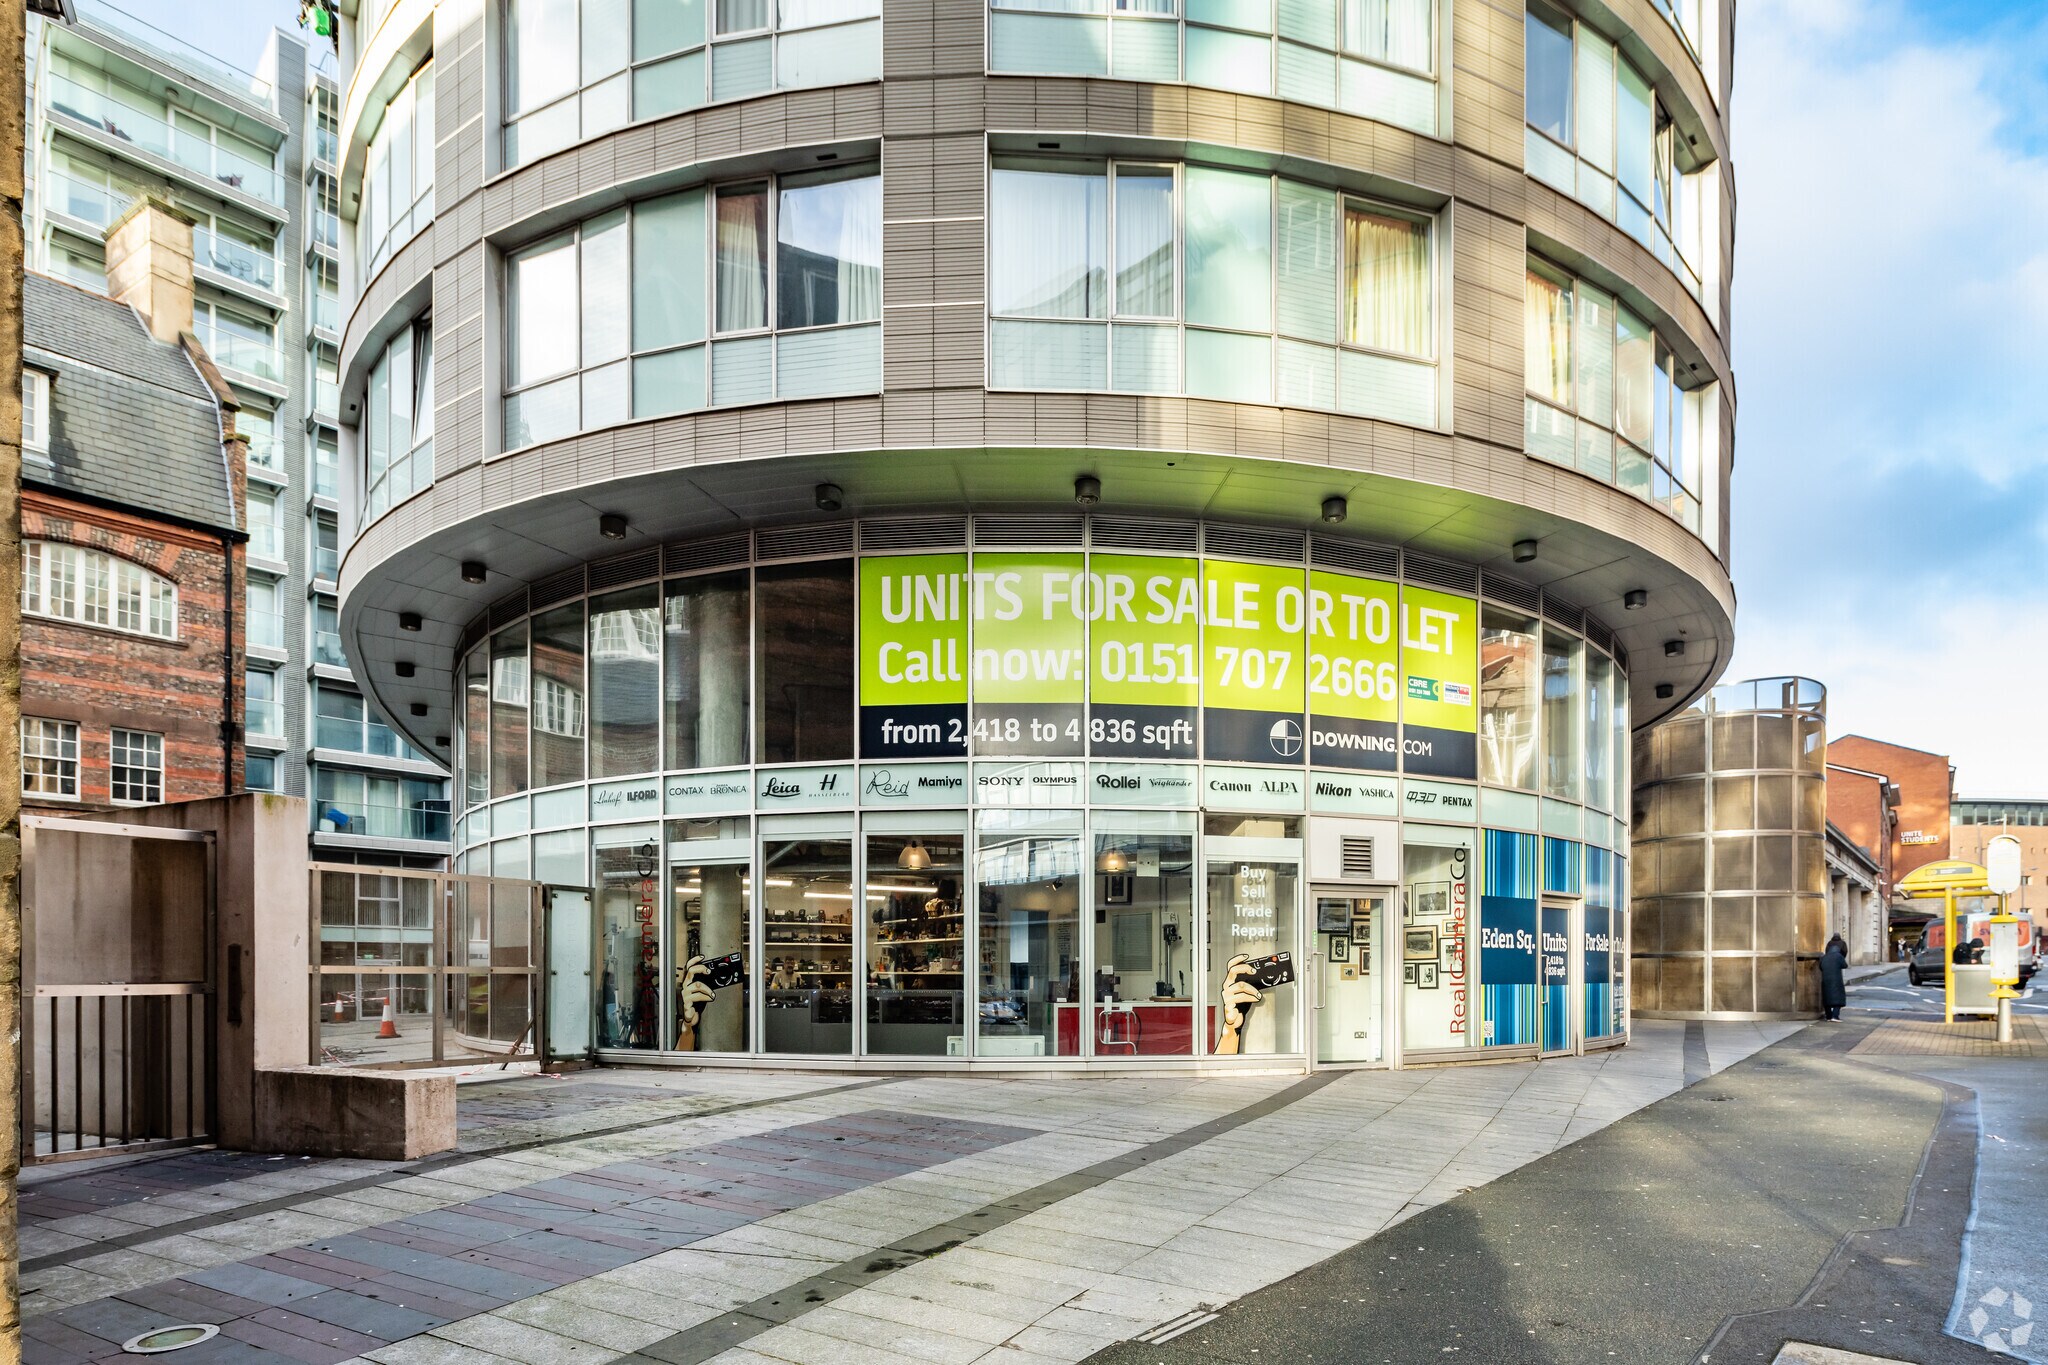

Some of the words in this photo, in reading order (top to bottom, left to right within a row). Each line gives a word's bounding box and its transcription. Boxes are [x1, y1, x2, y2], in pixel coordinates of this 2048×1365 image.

[881, 572, 1023, 624] UNITS
[1042, 572, 1137, 623] FOR
[1145, 576, 1260, 630] SALE
[1276, 585, 1335, 638] OR
[1341, 594, 1390, 644] TO
[1402, 603, 1460, 656] LET
[878, 638, 962, 684] Call
[974, 648, 1083, 681] now:
[1100, 640, 1199, 684] 0151
[1215, 645, 1291, 690] 707
[1309, 653, 1396, 701] 2666
[1408, 679, 1428, 688] CBRE
[881, 718, 941, 744] from
[947, 718, 1021, 748] 2,418
[1030, 718, 1058, 742] to
[1142, 719, 1193, 750] sqft
[1312, 730, 1433, 757] DOWNING.COM
[761, 777, 801, 798] Leica
[865, 769, 910, 797] Reid
[917, 776, 963, 789] Mamiya
[978, 776, 1024, 786] SONY
[1032, 776, 1078, 784] OLYMPUS
[1096, 774, 1141, 789] Rollei
[1209, 780, 1252, 792] Canon
[1259, 780, 1299, 793] ALPA
[626, 789, 657, 801] ILFORD
[668, 786, 704, 796] CONTAX
[710, 785, 747, 795] BRONICA
[1315, 782, 1352, 797] Nikon
[1359, 787, 1394, 799] YASHICA
[1442, 795, 1473, 808] PENTAX
[1901, 835, 1939, 843] STUDENTS
[1240, 865, 1267, 882] Buy
[1241, 885, 1266, 898] Sell
[1234, 904, 1273, 917] Trade
[1231, 923, 1276, 940] Repair
[1481, 927, 1515, 949] Eden
[1516, 929, 1536, 955] Sq.
[1542, 932, 1568, 952] Units
[1585, 932, 1596, 951] For
[1596, 933, 1609, 952] Sale
